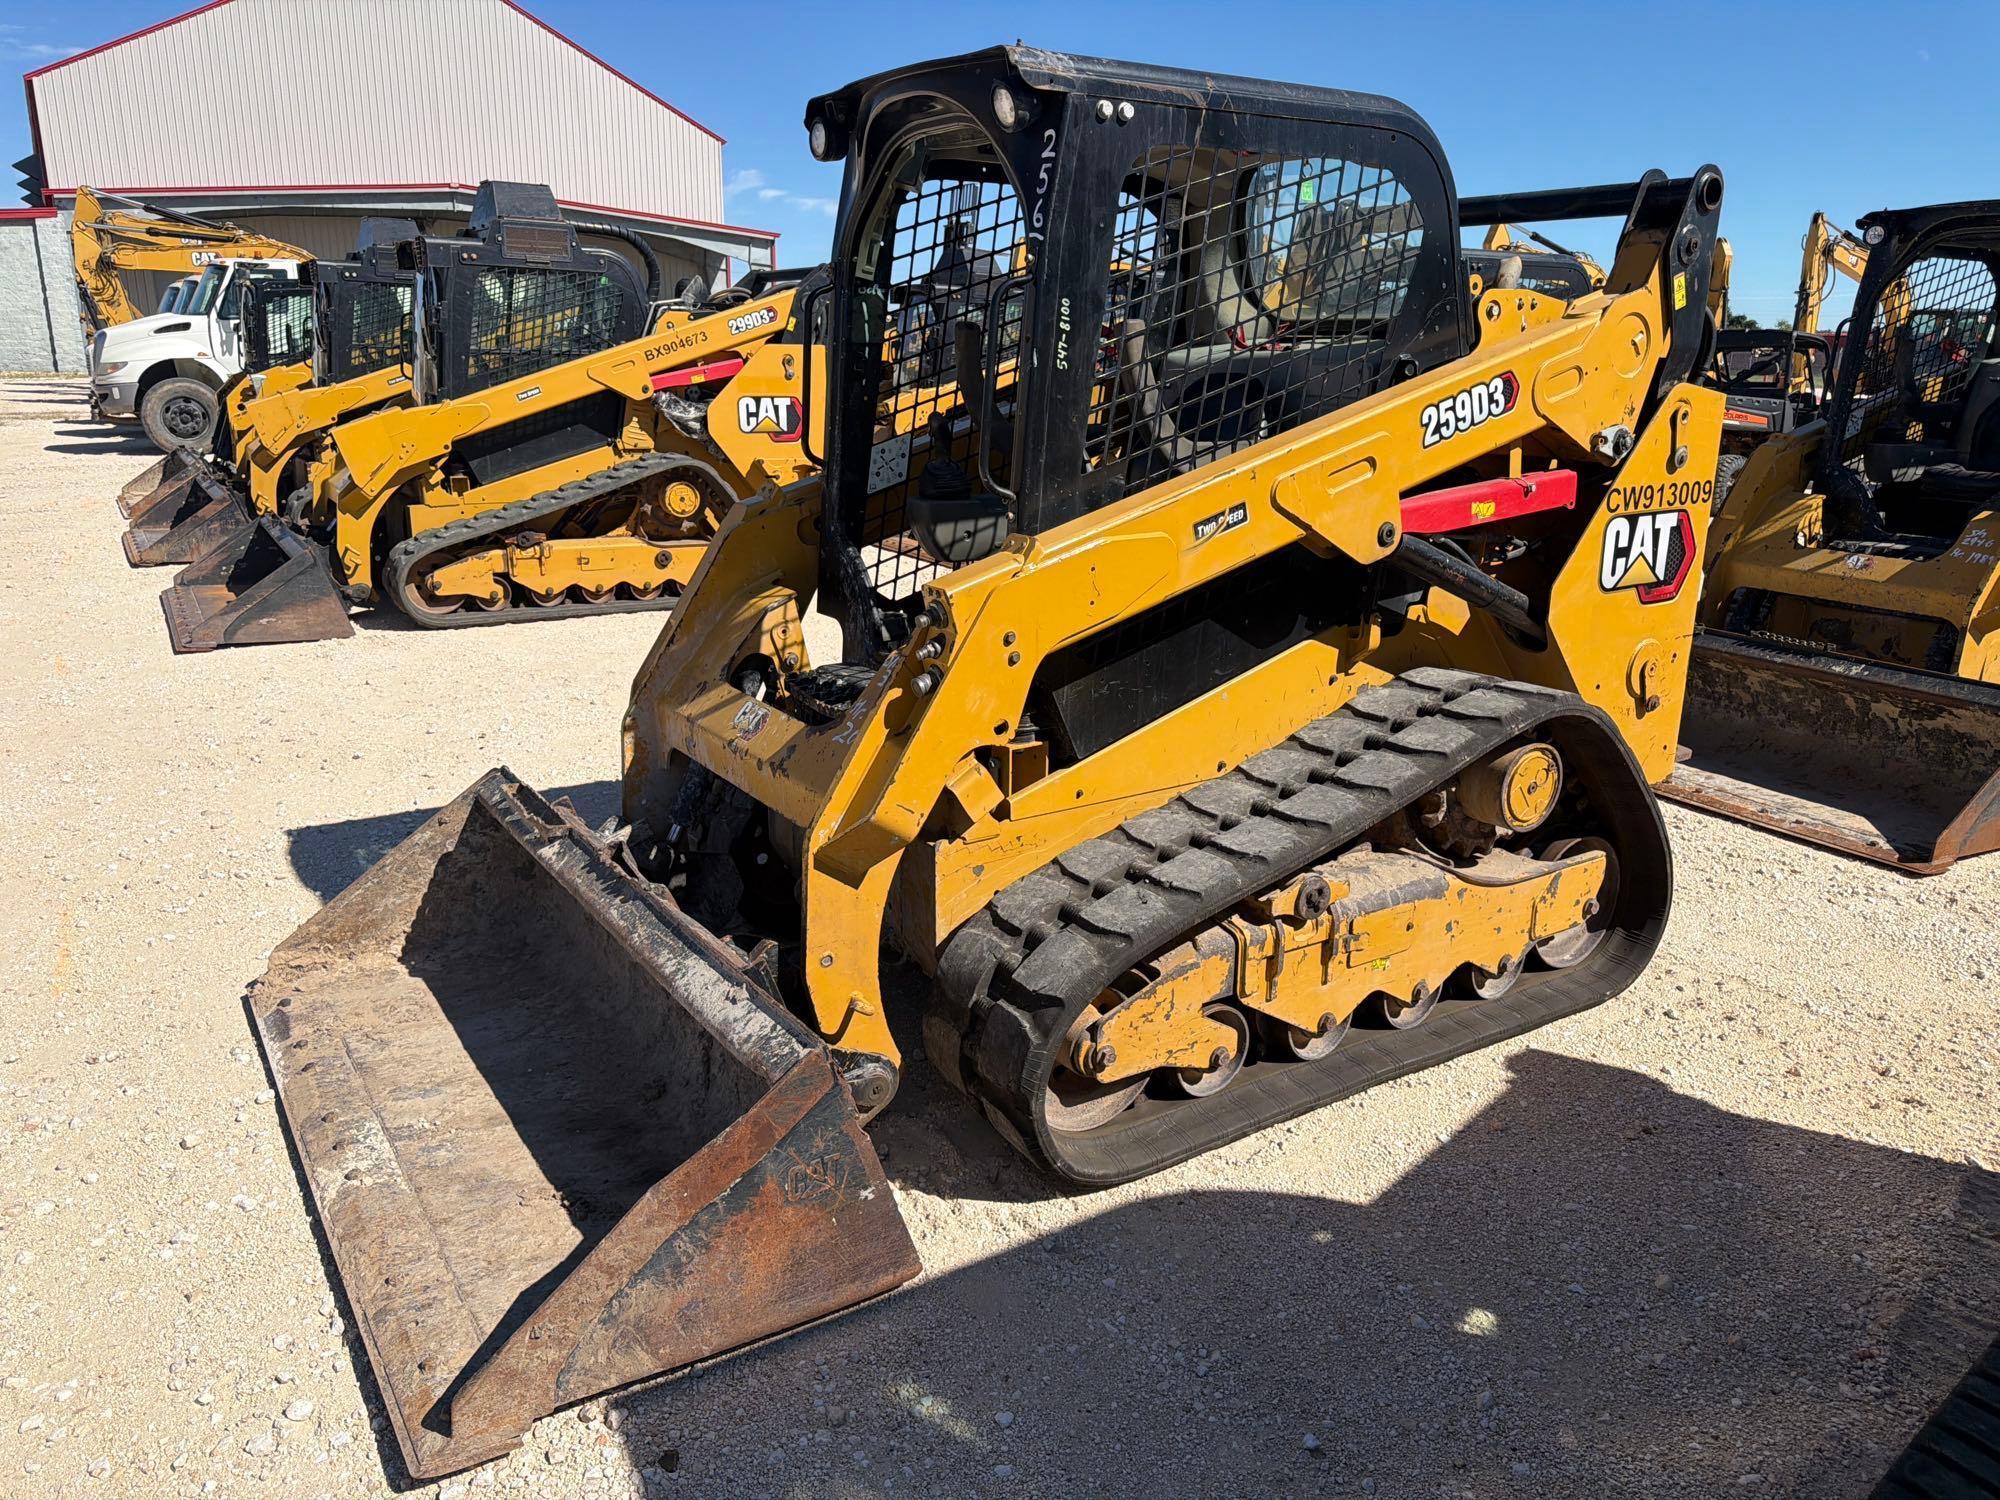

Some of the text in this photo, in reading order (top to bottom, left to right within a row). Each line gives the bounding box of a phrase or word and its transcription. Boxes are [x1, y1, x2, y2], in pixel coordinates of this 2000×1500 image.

[191, 251, 217, 267] CAT
[644, 331, 708, 362] BX904673
[1055, 297, 1072, 371] 547-8100
[739, 396, 792, 433] CAT
[1422, 377, 1506, 448] 259D3
[1606, 479, 1714, 513] CW913009
[1601, 511, 1679, 590] CAT
